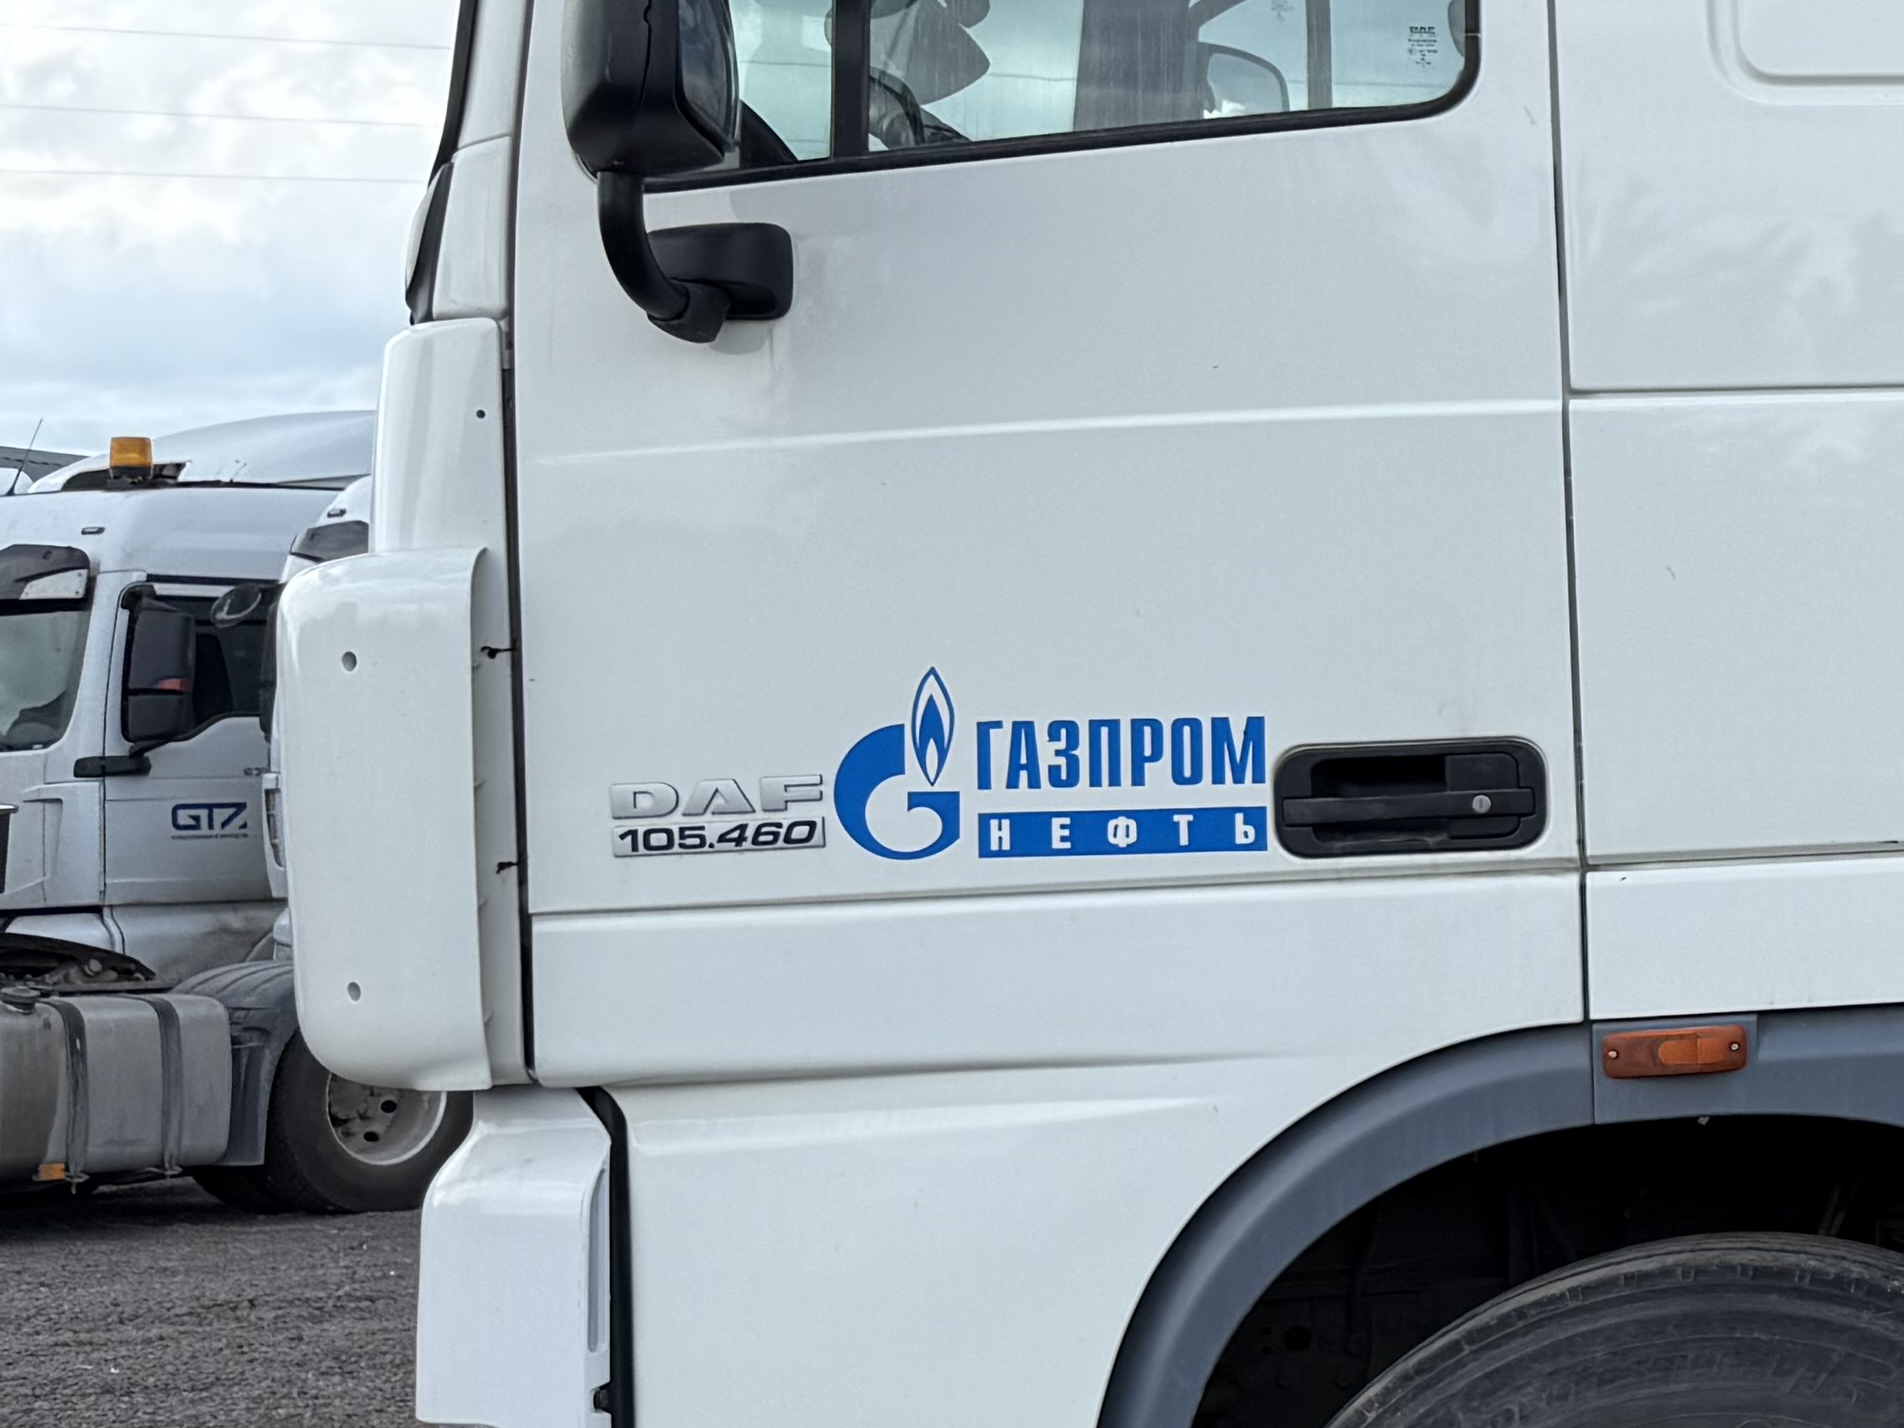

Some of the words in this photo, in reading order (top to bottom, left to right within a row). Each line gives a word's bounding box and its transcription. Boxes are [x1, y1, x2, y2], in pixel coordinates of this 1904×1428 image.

[976, 716, 1266, 790] ГАЗПРОМ
[610, 774, 823, 819] DAF
[618, 820, 818, 853] 105.460
[989, 812, 1256, 852] НЕФТЬ
